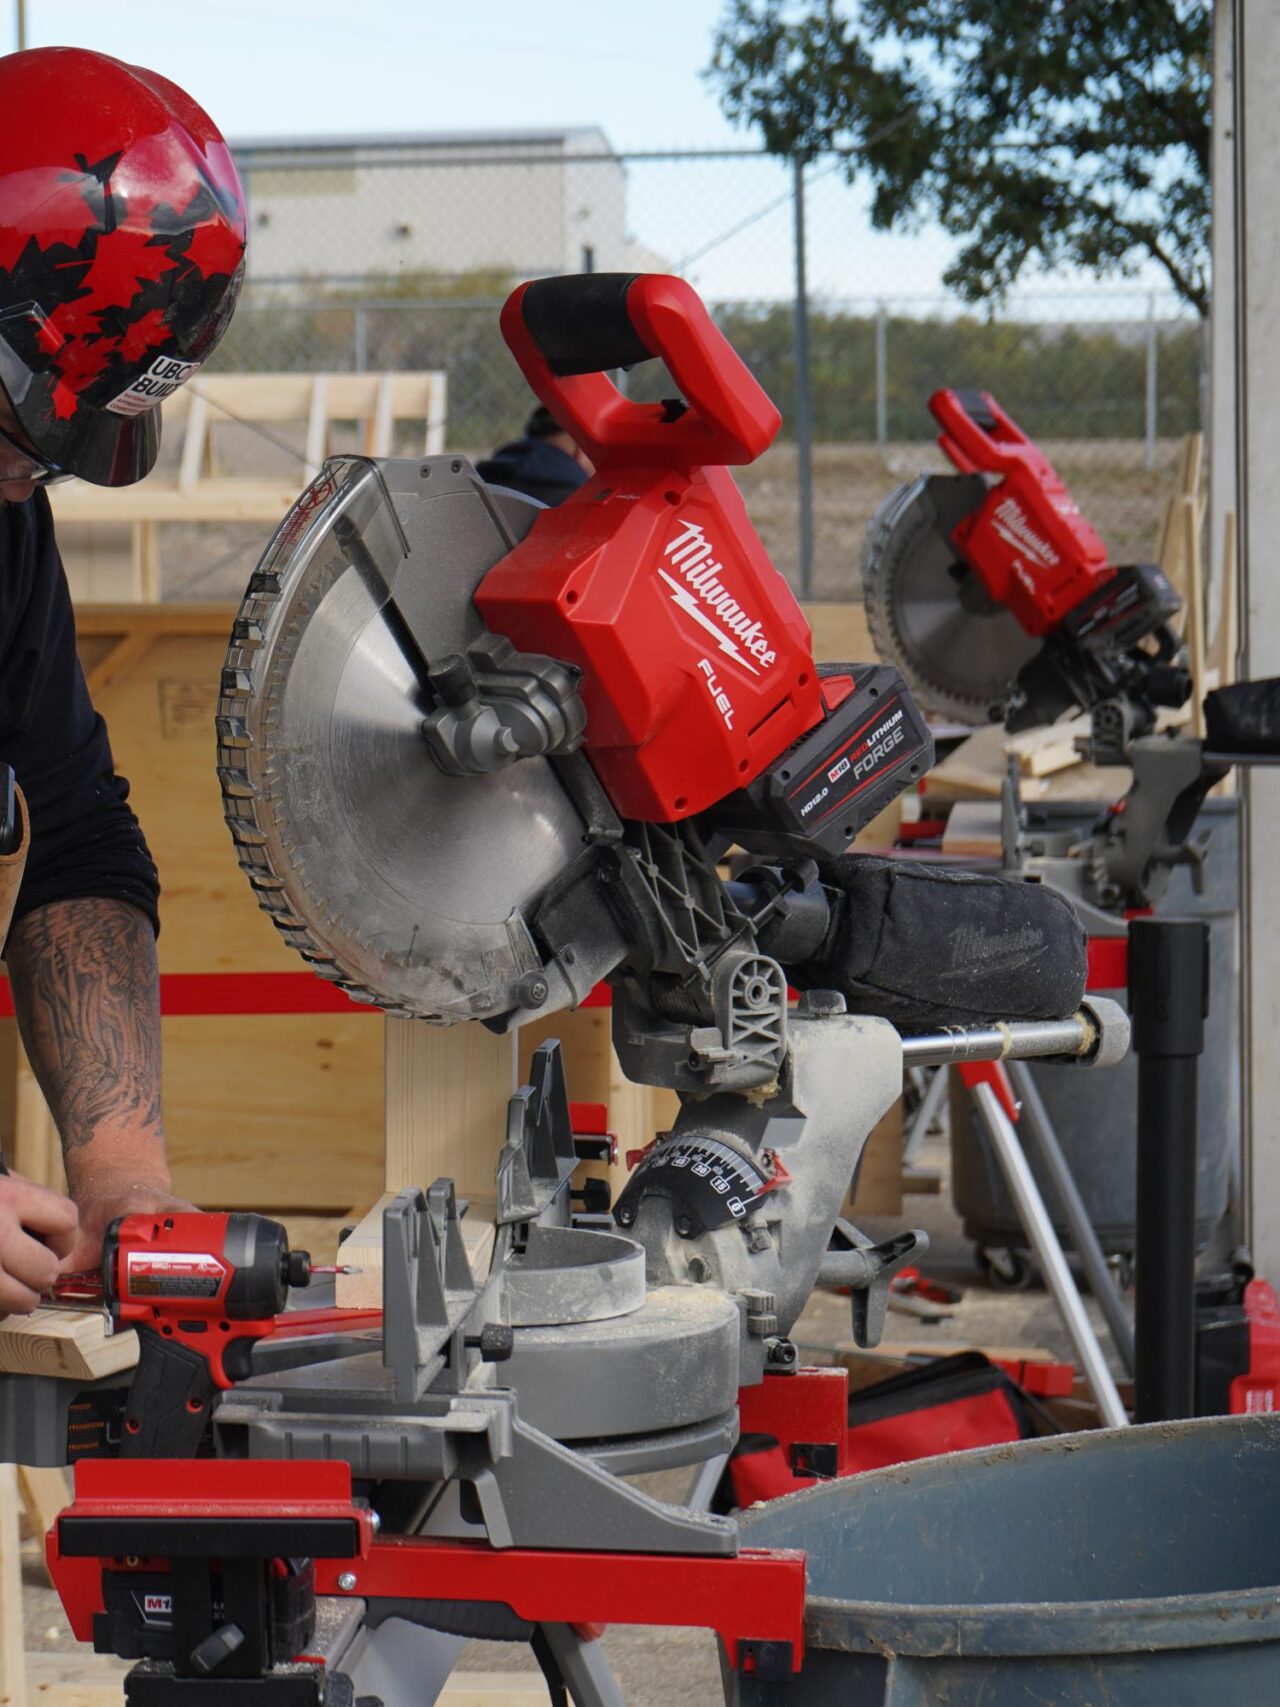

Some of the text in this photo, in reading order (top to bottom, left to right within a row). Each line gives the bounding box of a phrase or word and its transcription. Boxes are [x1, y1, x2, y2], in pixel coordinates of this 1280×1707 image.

[664, 519, 776, 668] Milwaukee
[697, 659, 734, 730] FUEL
[829, 759, 850, 781] M18
[853, 726, 905, 780] FORGE
[800, 787, 829, 816] HD12.0
[146, 1599, 171, 1610] M1
